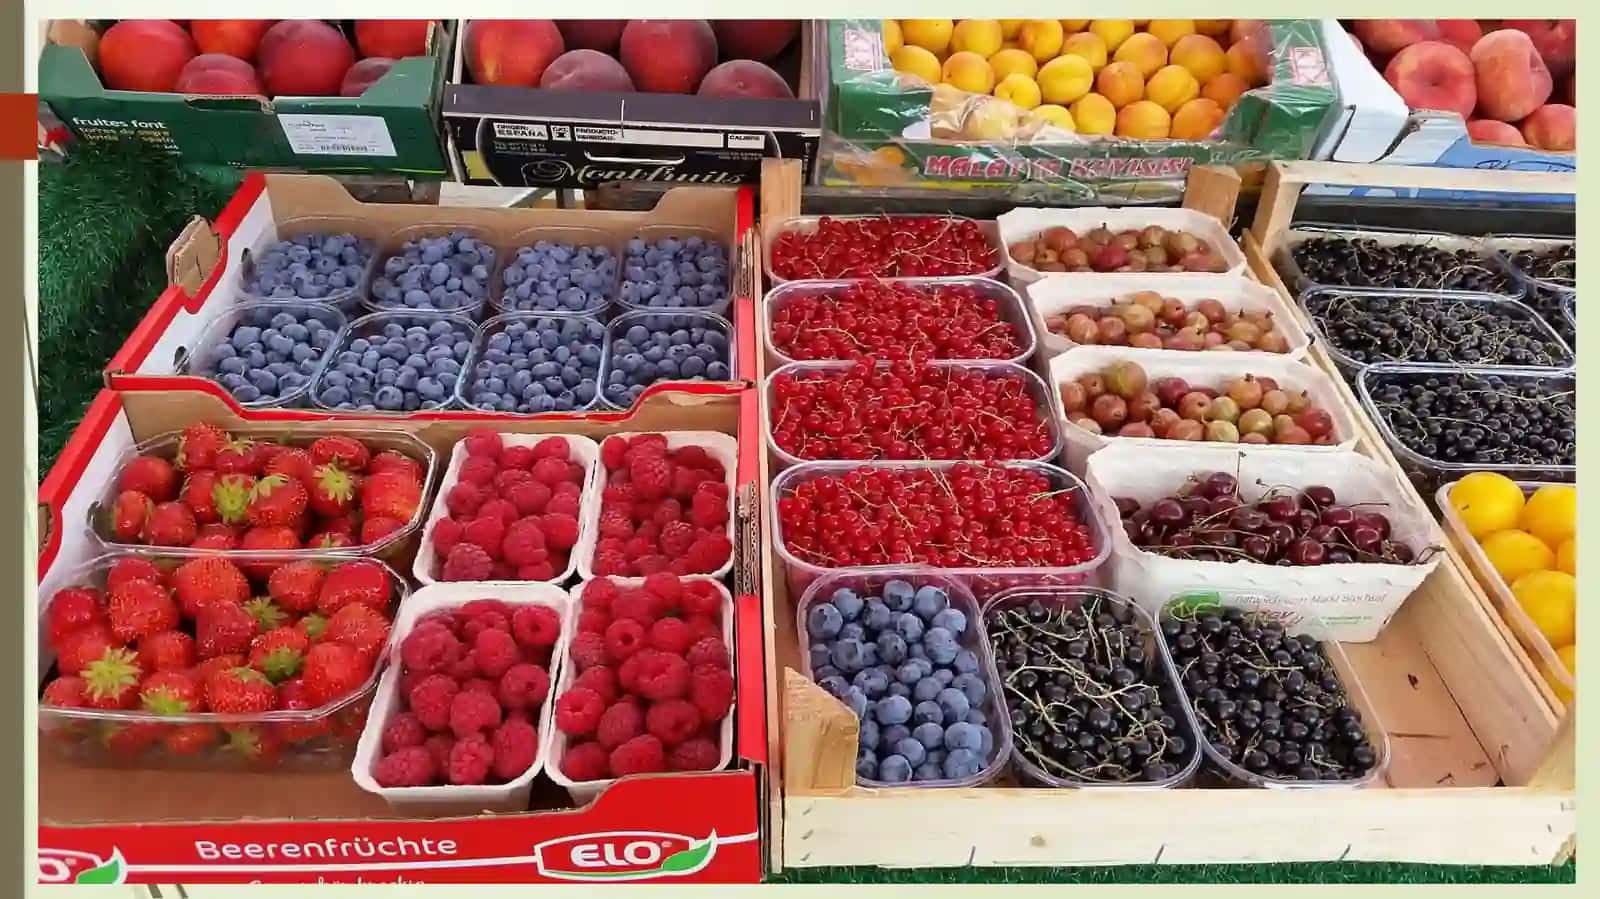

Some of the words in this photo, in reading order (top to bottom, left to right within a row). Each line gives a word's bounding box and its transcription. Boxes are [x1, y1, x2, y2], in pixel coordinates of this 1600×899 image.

[131, 119, 168, 130] font
[496, 128, 546, 138] ESPAÑA
[194, 837, 457, 860] Beerenfrüchte
[570, 840, 661, 867] ELO
